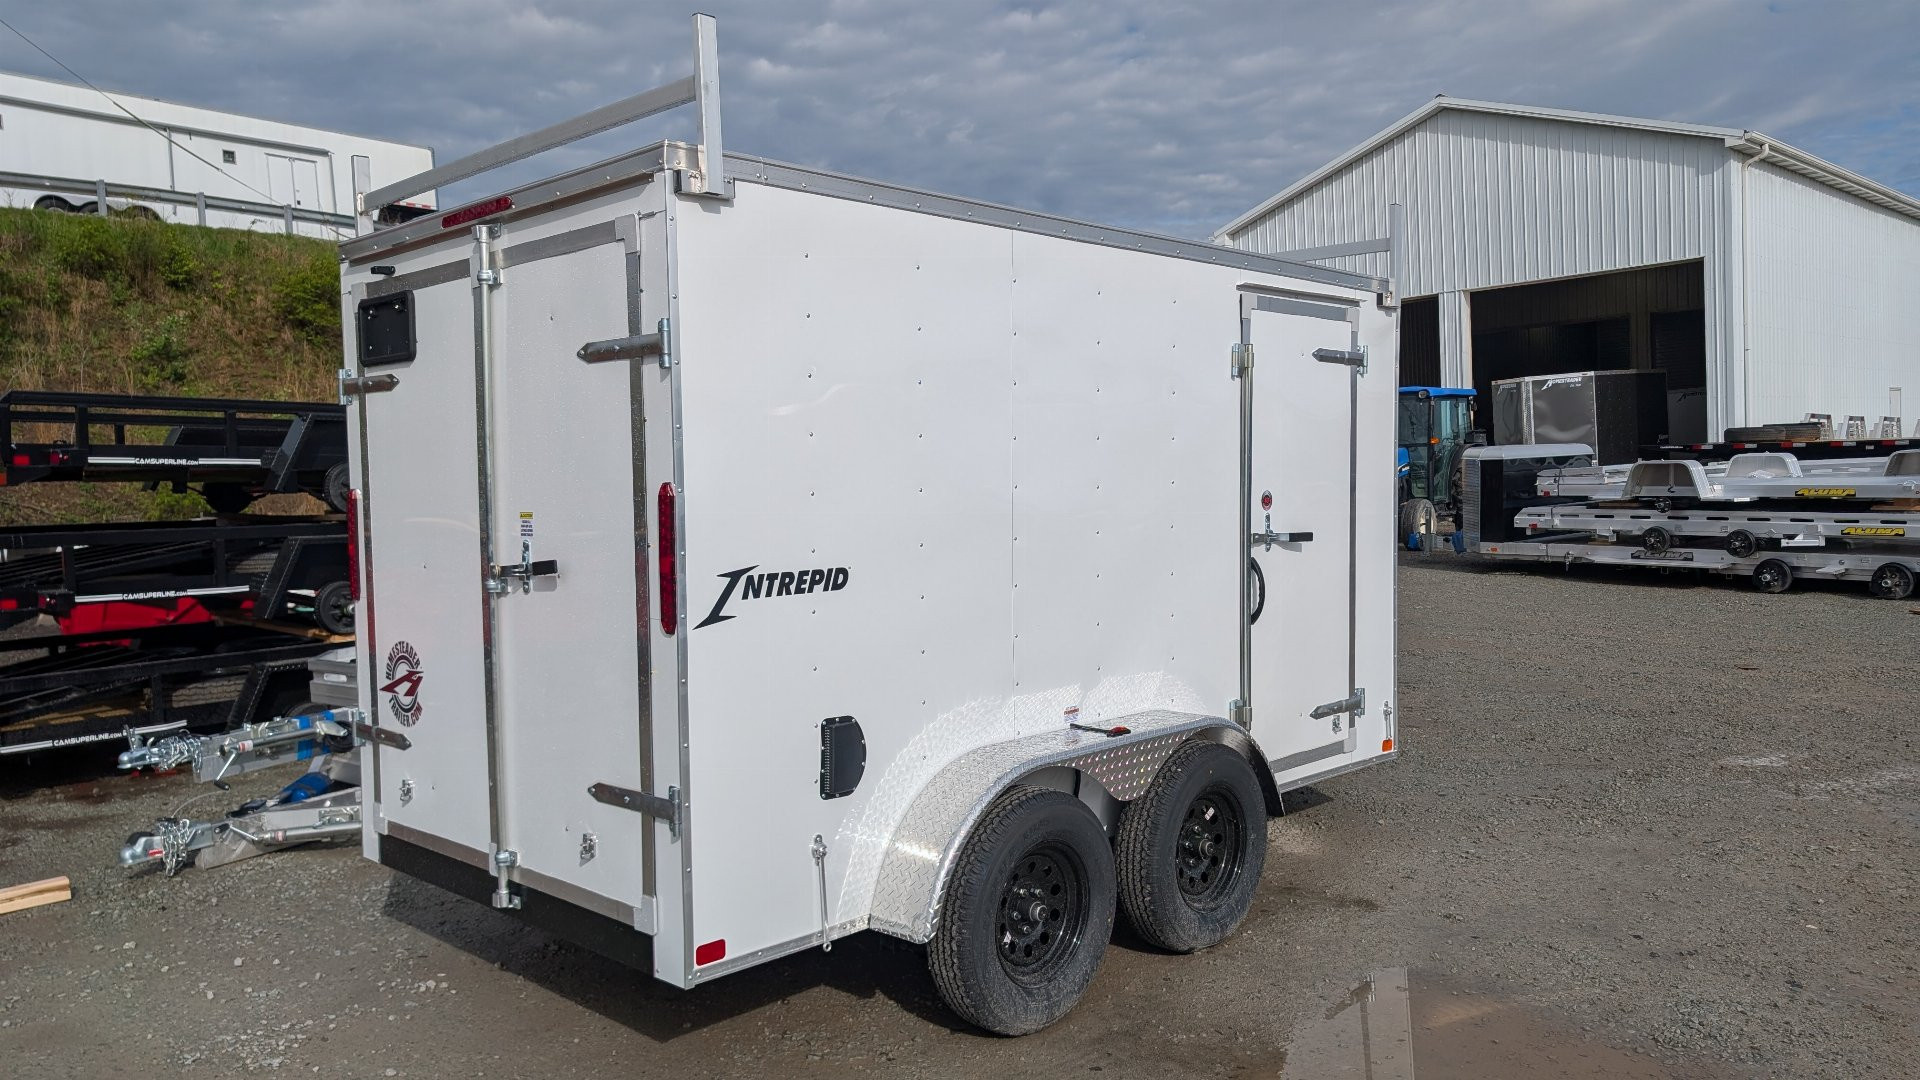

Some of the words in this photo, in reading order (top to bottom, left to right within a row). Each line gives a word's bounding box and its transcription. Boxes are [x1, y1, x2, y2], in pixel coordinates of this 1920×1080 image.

[1795, 488, 1857, 497] ALUMA
[1841, 527, 1905, 537] ALUMA
[123, 590, 188, 600] CAMSUPERLINE.COM
[692, 564, 850, 630] INTREPID
[385, 640, 421, 681] HOMESTEADER
[53, 732, 122, 747] CAMSUPERLINE.COM
